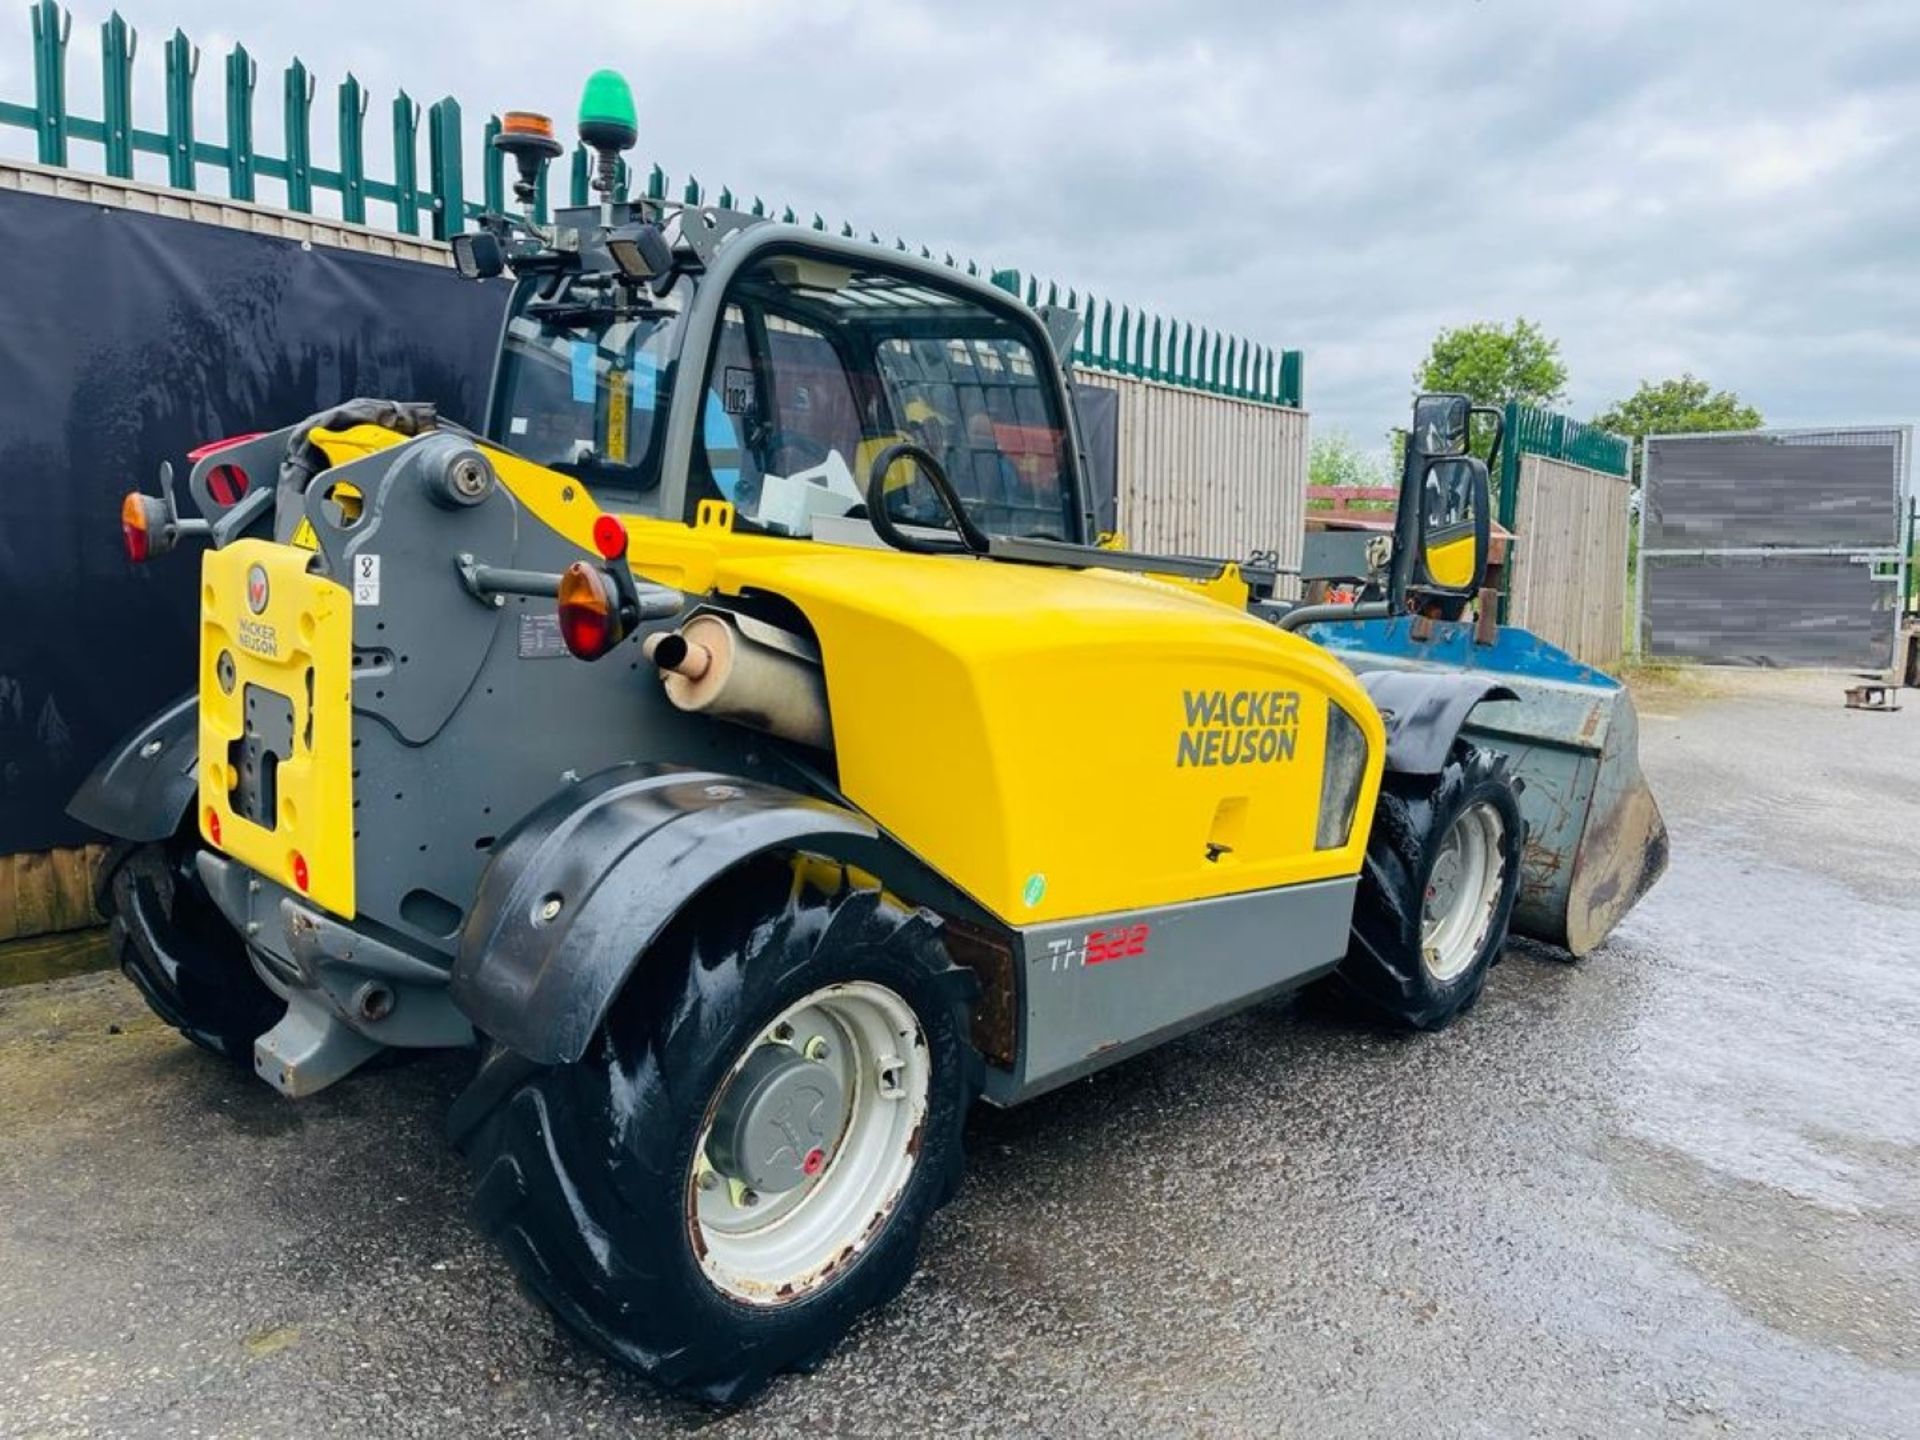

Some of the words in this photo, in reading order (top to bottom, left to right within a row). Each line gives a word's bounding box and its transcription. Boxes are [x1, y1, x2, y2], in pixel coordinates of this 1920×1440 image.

[728, 388, 746, 411] 103
[239, 618, 277, 641] WACKER
[239, 633, 278, 657] NEUSON
[1183, 690, 1300, 727] WACKER
[1176, 728, 1298, 767] NEUSON
